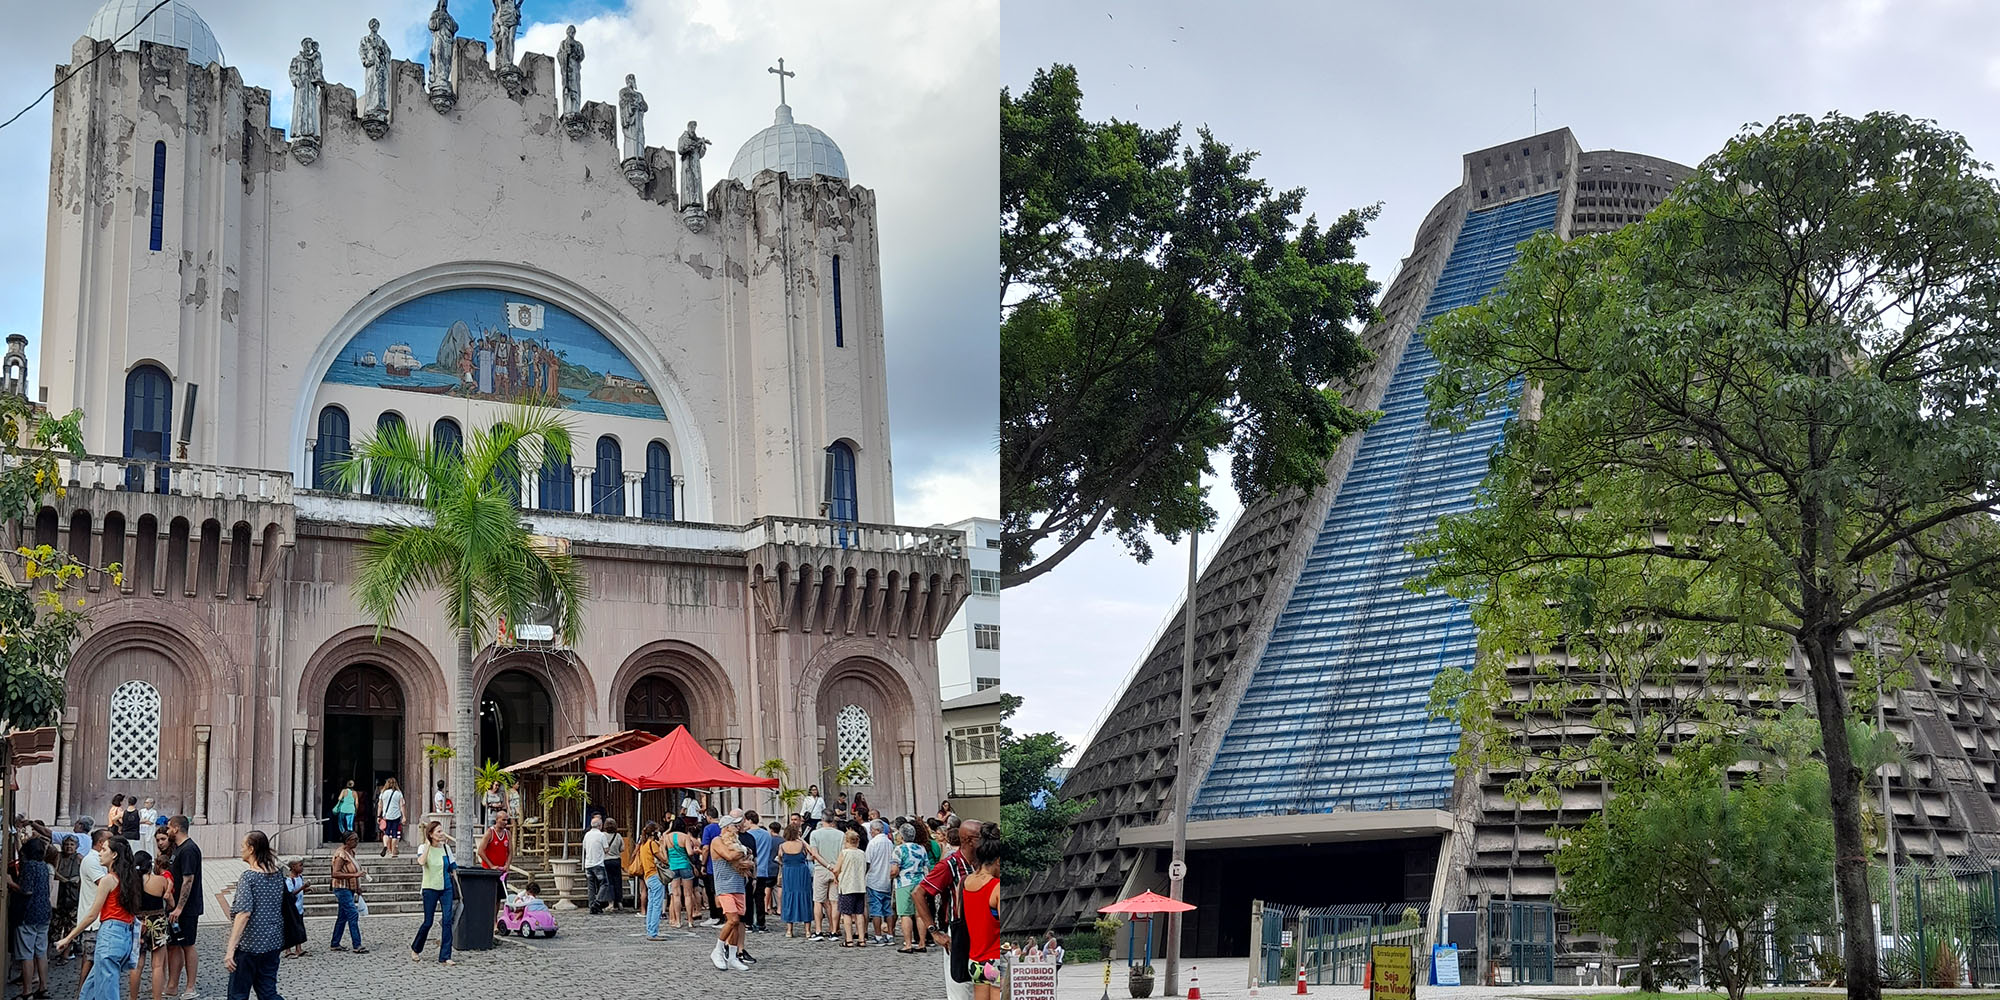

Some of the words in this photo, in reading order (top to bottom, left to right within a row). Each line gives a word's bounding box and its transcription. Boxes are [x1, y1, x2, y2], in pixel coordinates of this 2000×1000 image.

[1013, 967, 1054, 975] PROIBIDO
[1384, 971, 1399, 984] Seja
[1375, 982, 1389, 993] Bem
[1390, 983, 1410, 994] Vindo
